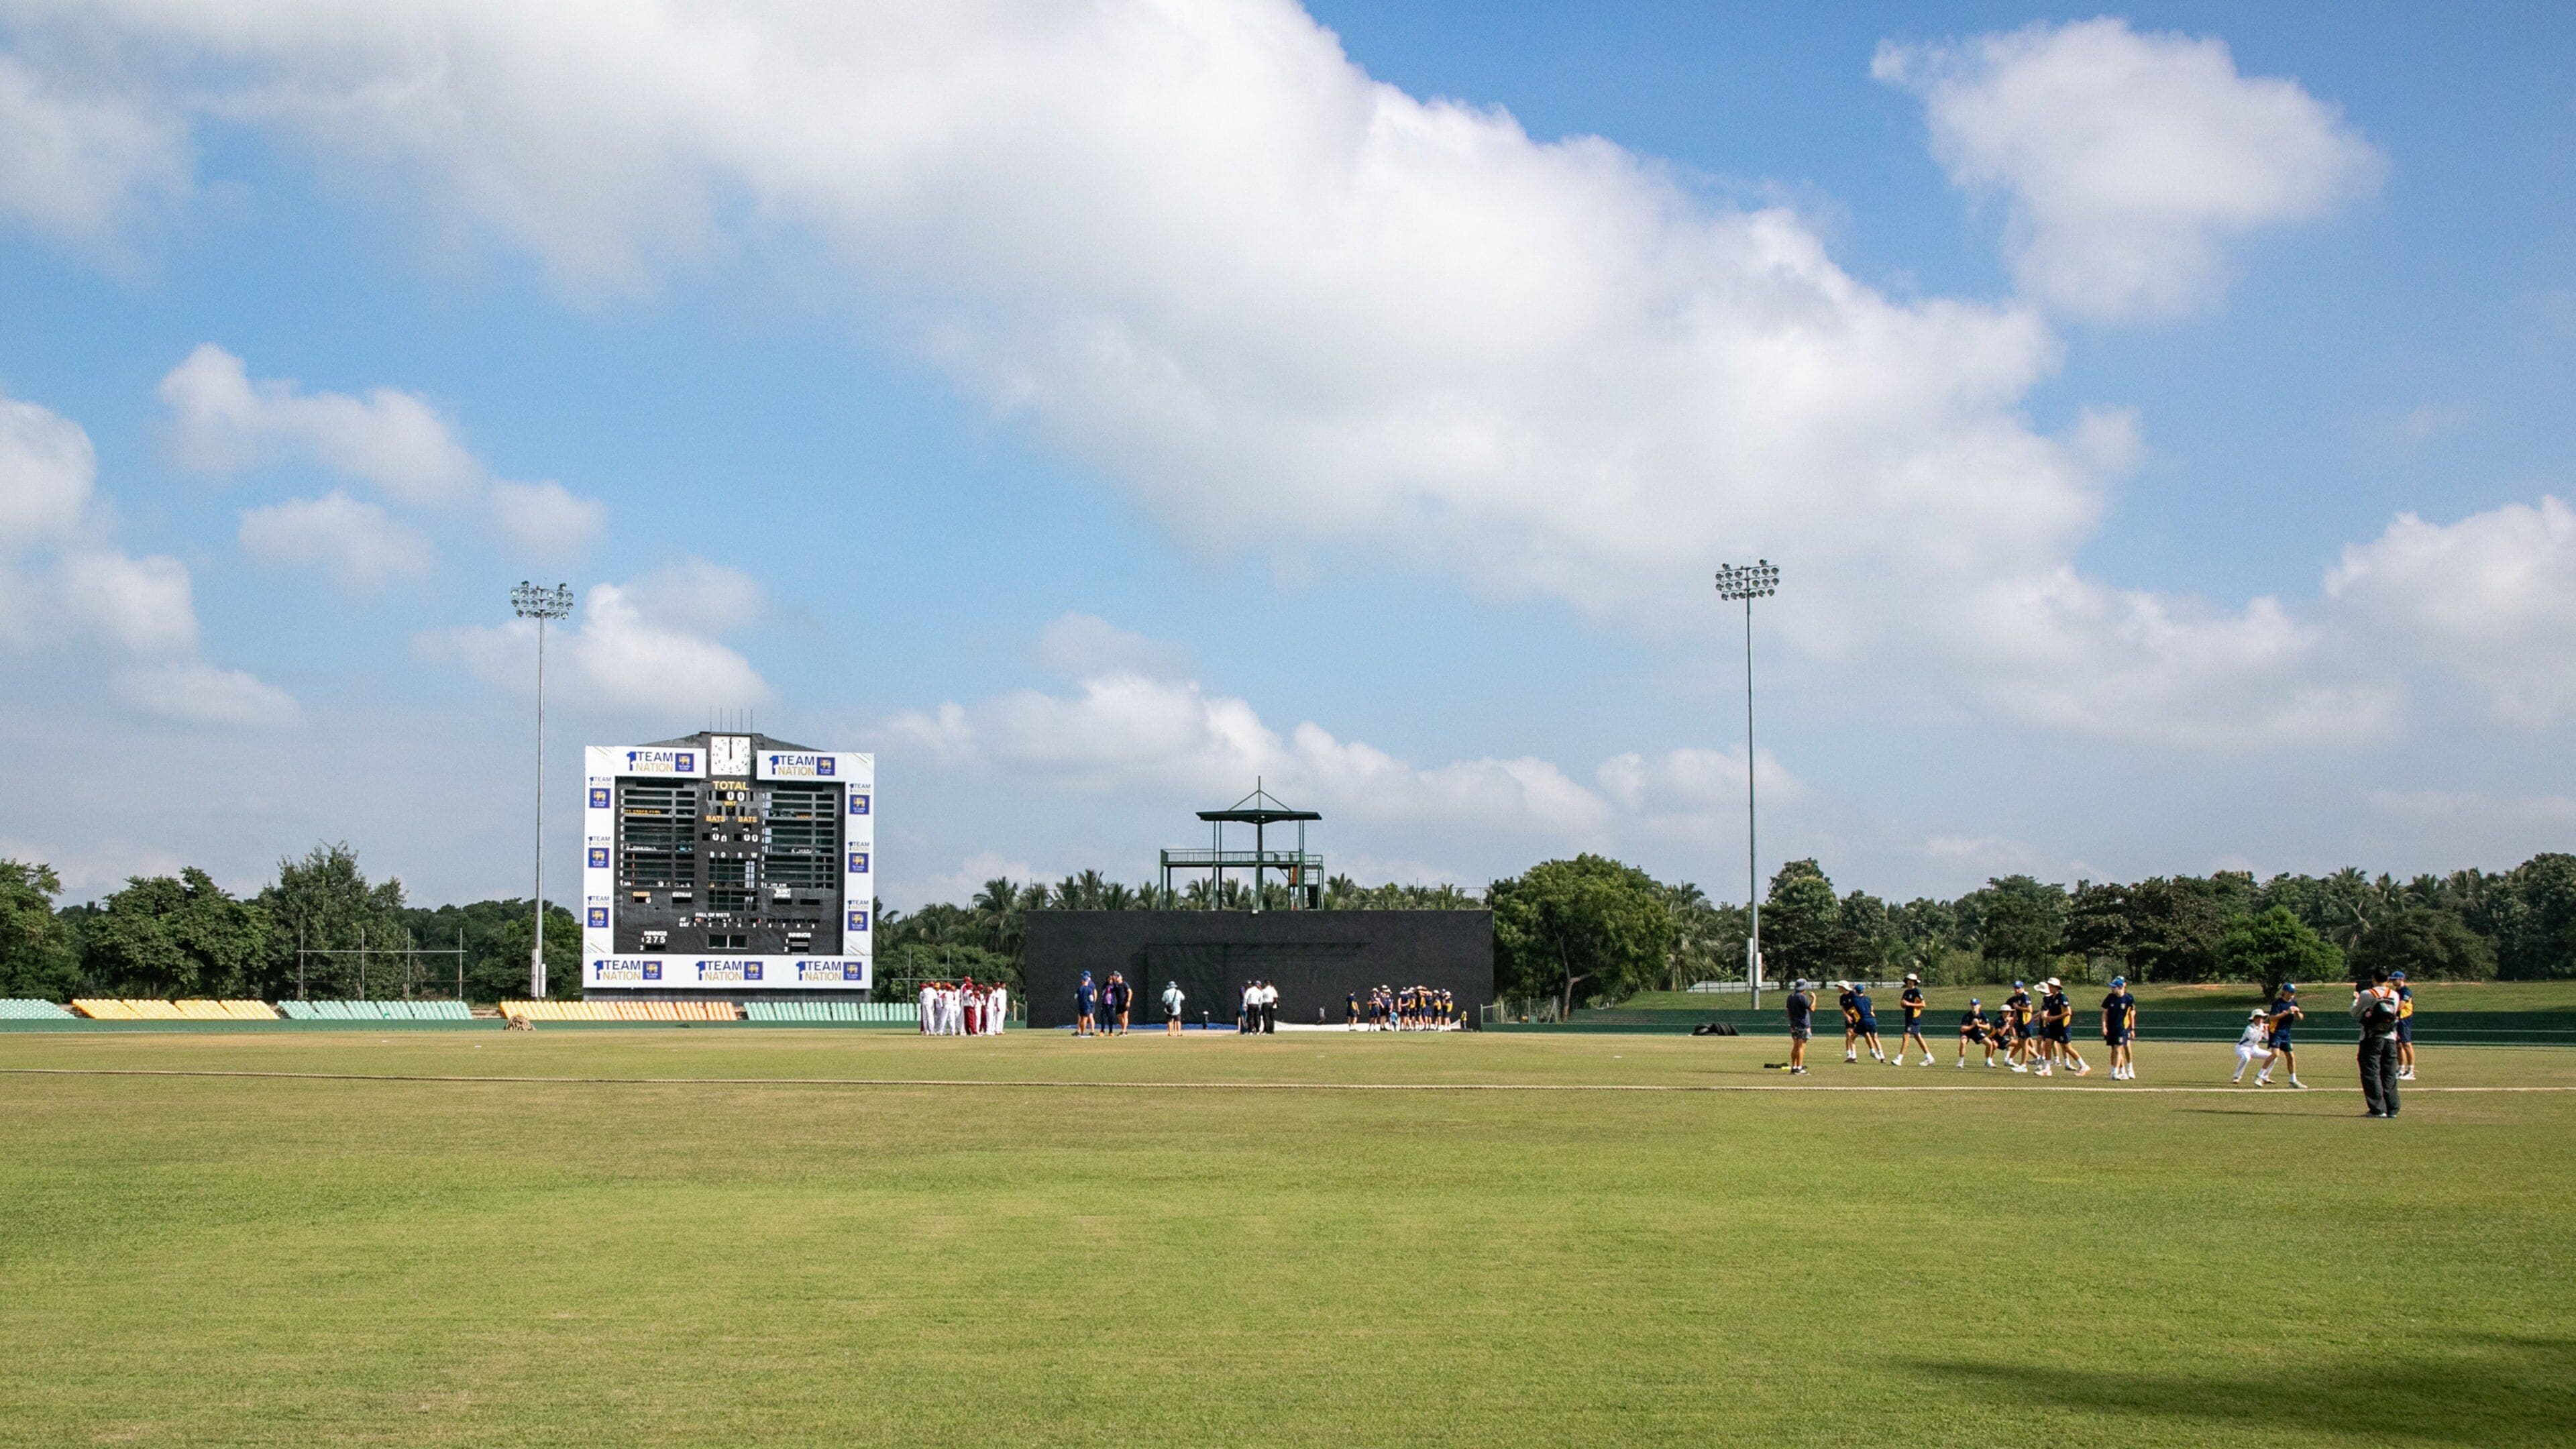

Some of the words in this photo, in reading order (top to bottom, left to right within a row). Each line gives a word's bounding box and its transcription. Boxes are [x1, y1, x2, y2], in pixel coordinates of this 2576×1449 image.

[637, 751, 673, 762] TEAM
[780, 755, 814, 765] TEAM
[636, 763, 673, 772] NATION
[778, 767, 814, 776] NATION
[712, 781, 749, 790] TOTAL
[604, 960, 641, 970] TEAM
[706, 961, 742, 971] TEAM
[806, 961, 841, 971] TEAM
[603, 971, 641, 981] NATION
[705, 971, 742, 981] NATION
[805, 971, 841, 981] NATION
